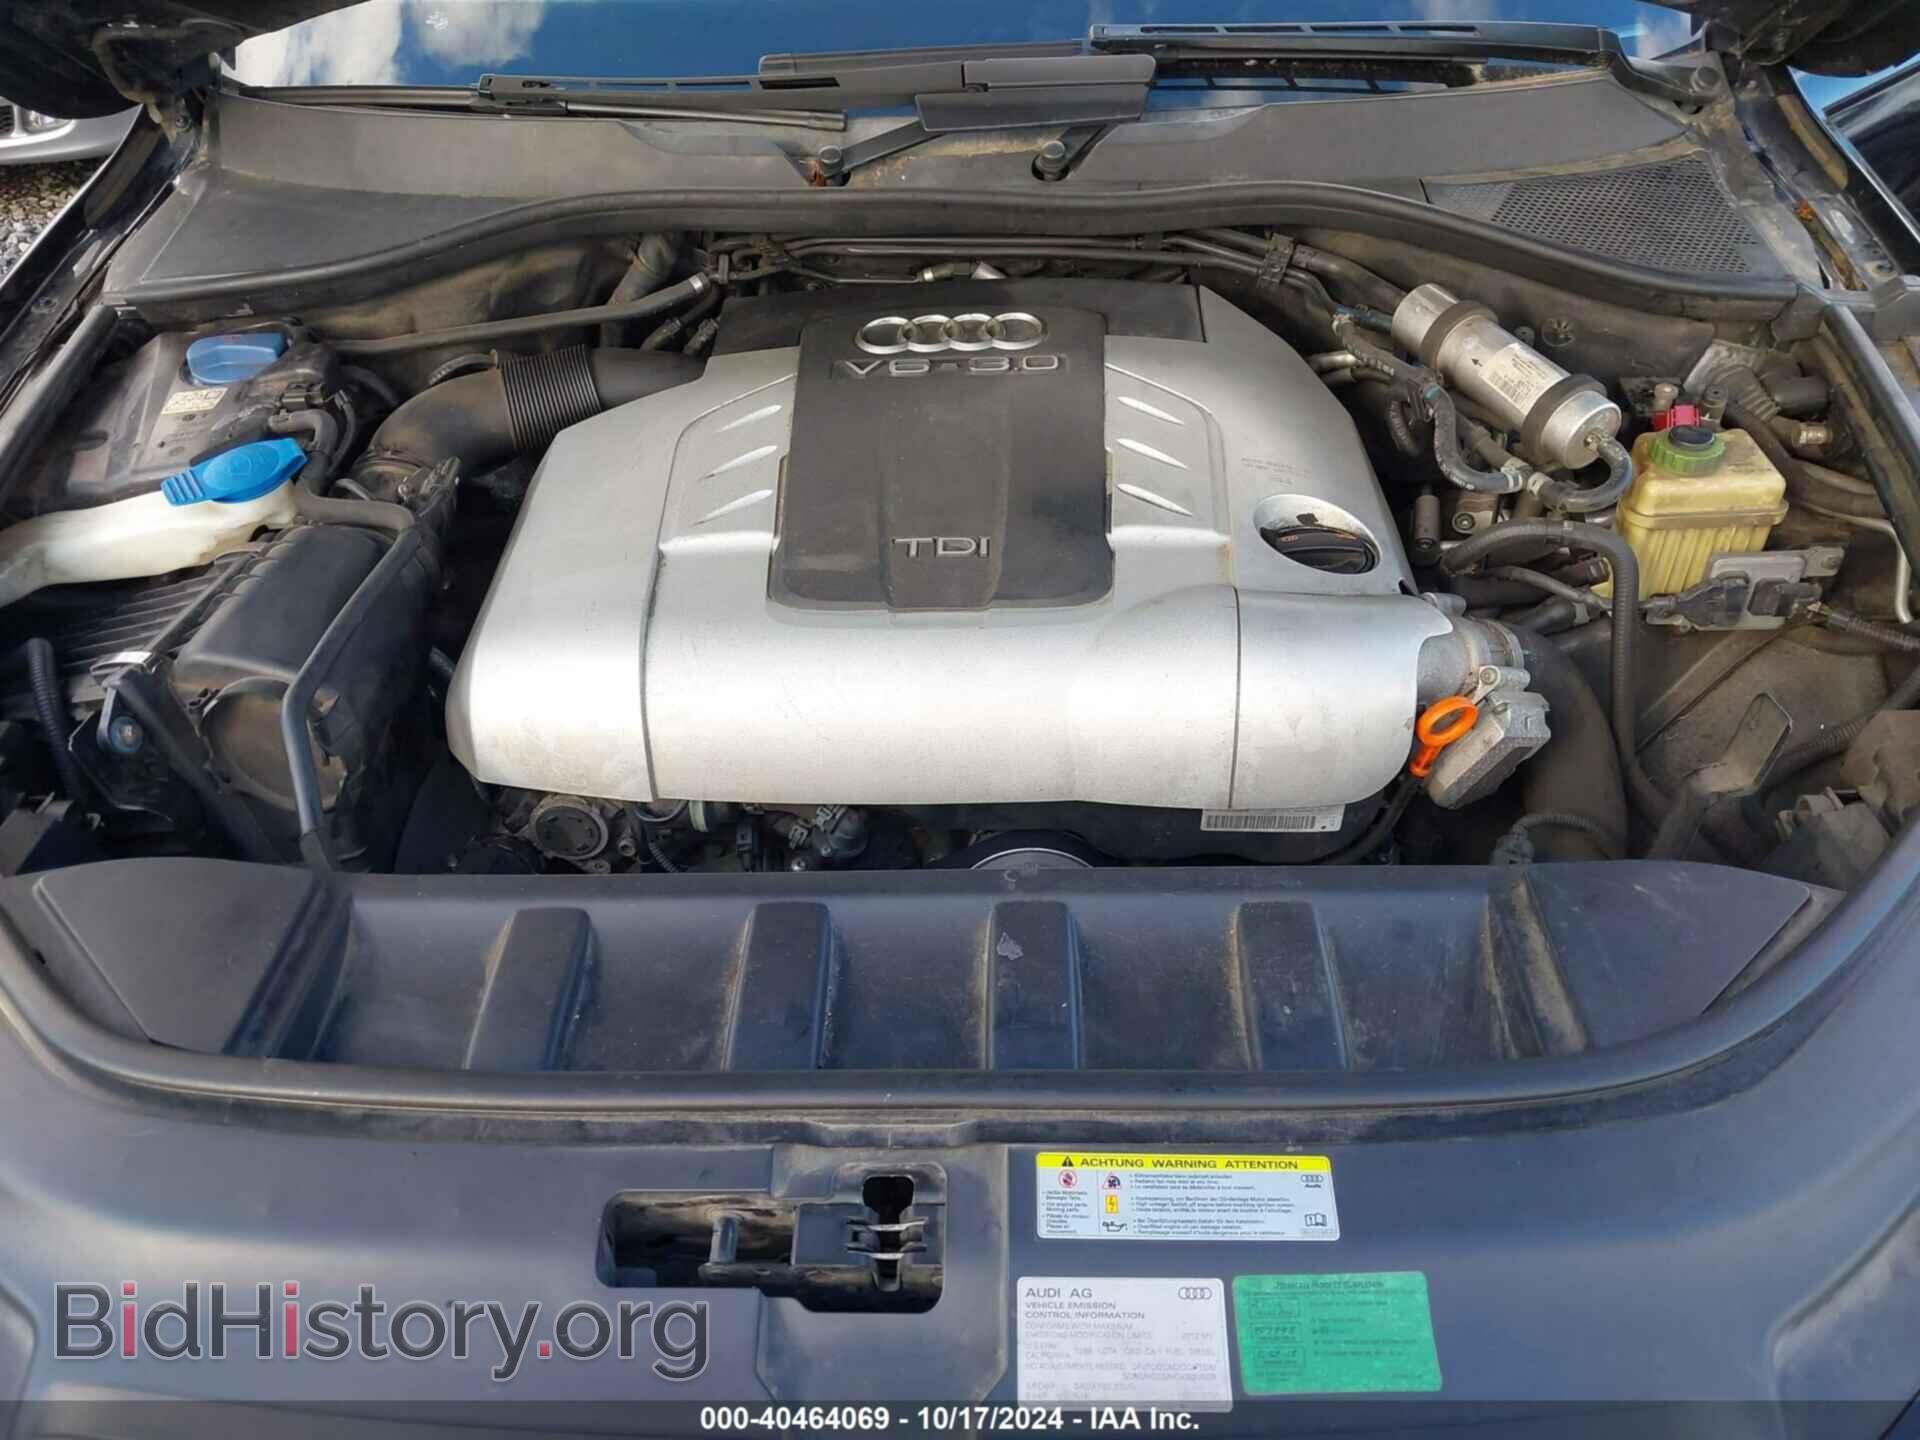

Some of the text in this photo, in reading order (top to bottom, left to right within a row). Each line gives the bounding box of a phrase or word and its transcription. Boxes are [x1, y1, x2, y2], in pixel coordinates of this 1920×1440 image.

[893, 536, 990, 558] TDI
[1080, 1158, 1298, 1170] ACHTUNG WARNING ATTENTION
[1025, 1287, 1093, 1298] AUDI AG
[1024, 1302, 1117, 1310] VEHICLE EMISSION
[1024, 1311, 1145, 1319] CONTROL INFORMATION
